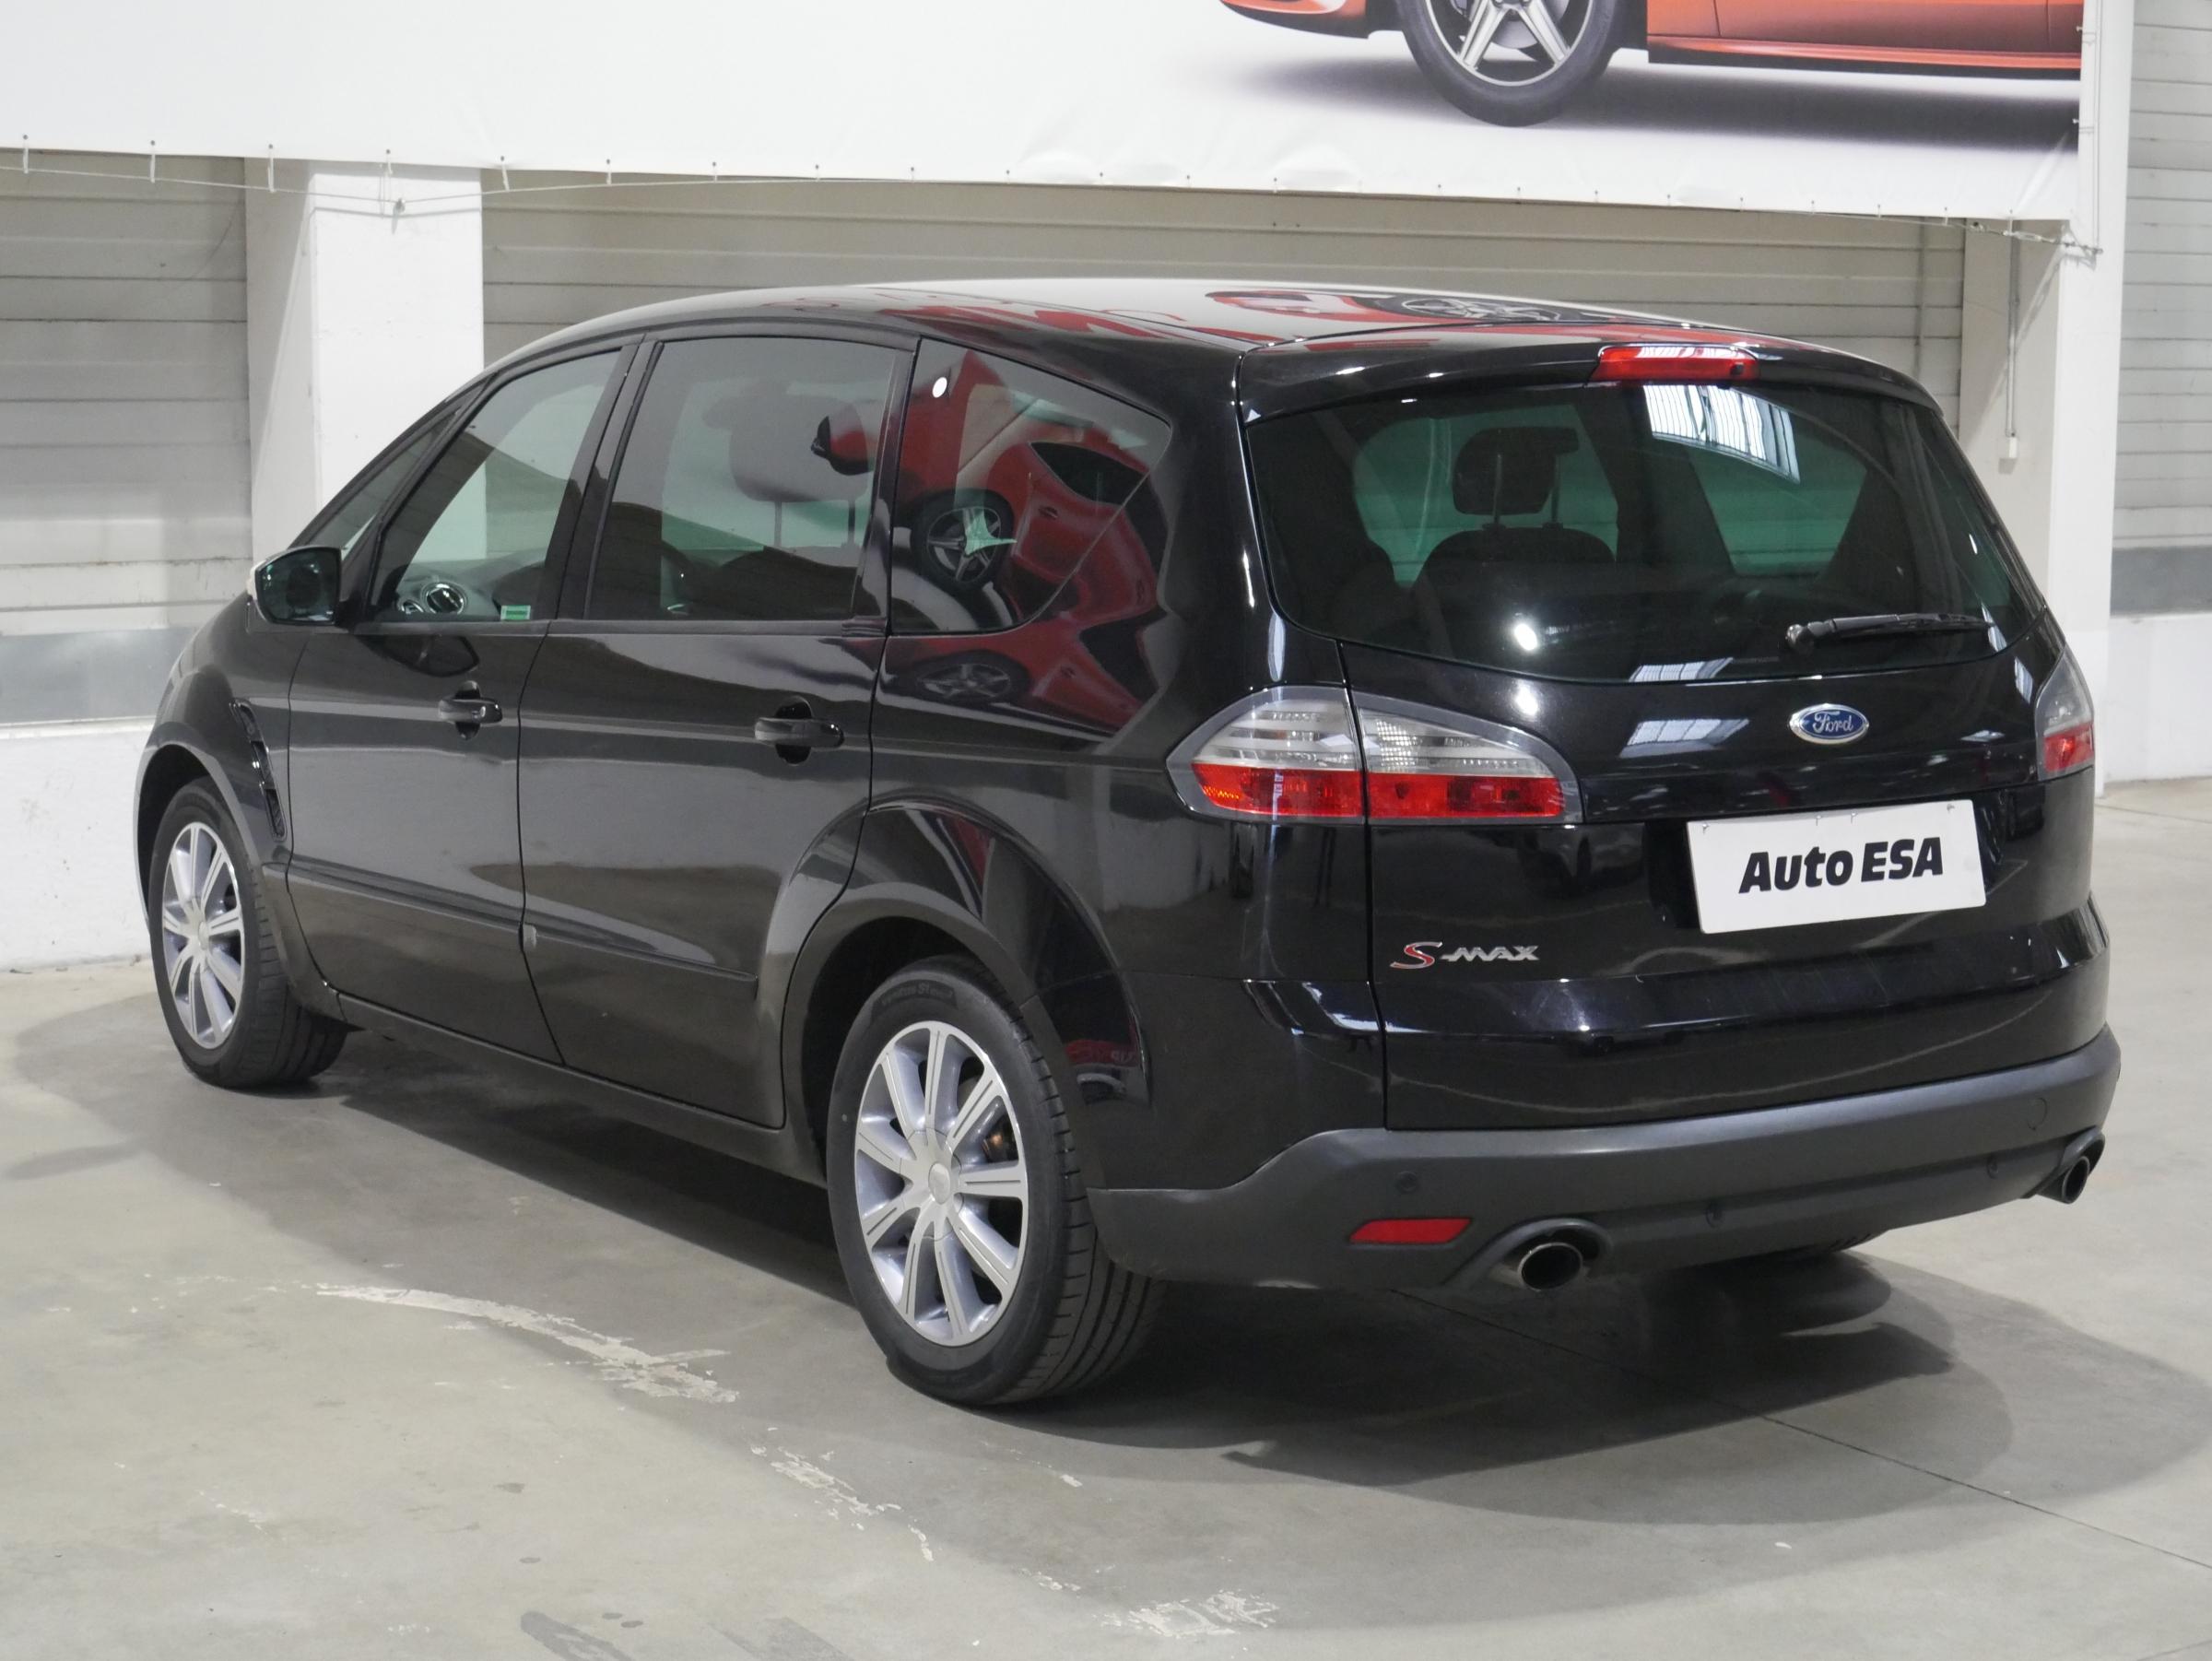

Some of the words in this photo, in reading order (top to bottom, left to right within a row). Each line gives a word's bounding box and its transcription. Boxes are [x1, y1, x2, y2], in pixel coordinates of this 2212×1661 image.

[1812, 710, 1853, 734] Ford
[1738, 846, 1853, 893] Auto
[1861, 837, 1944, 882] ESA
